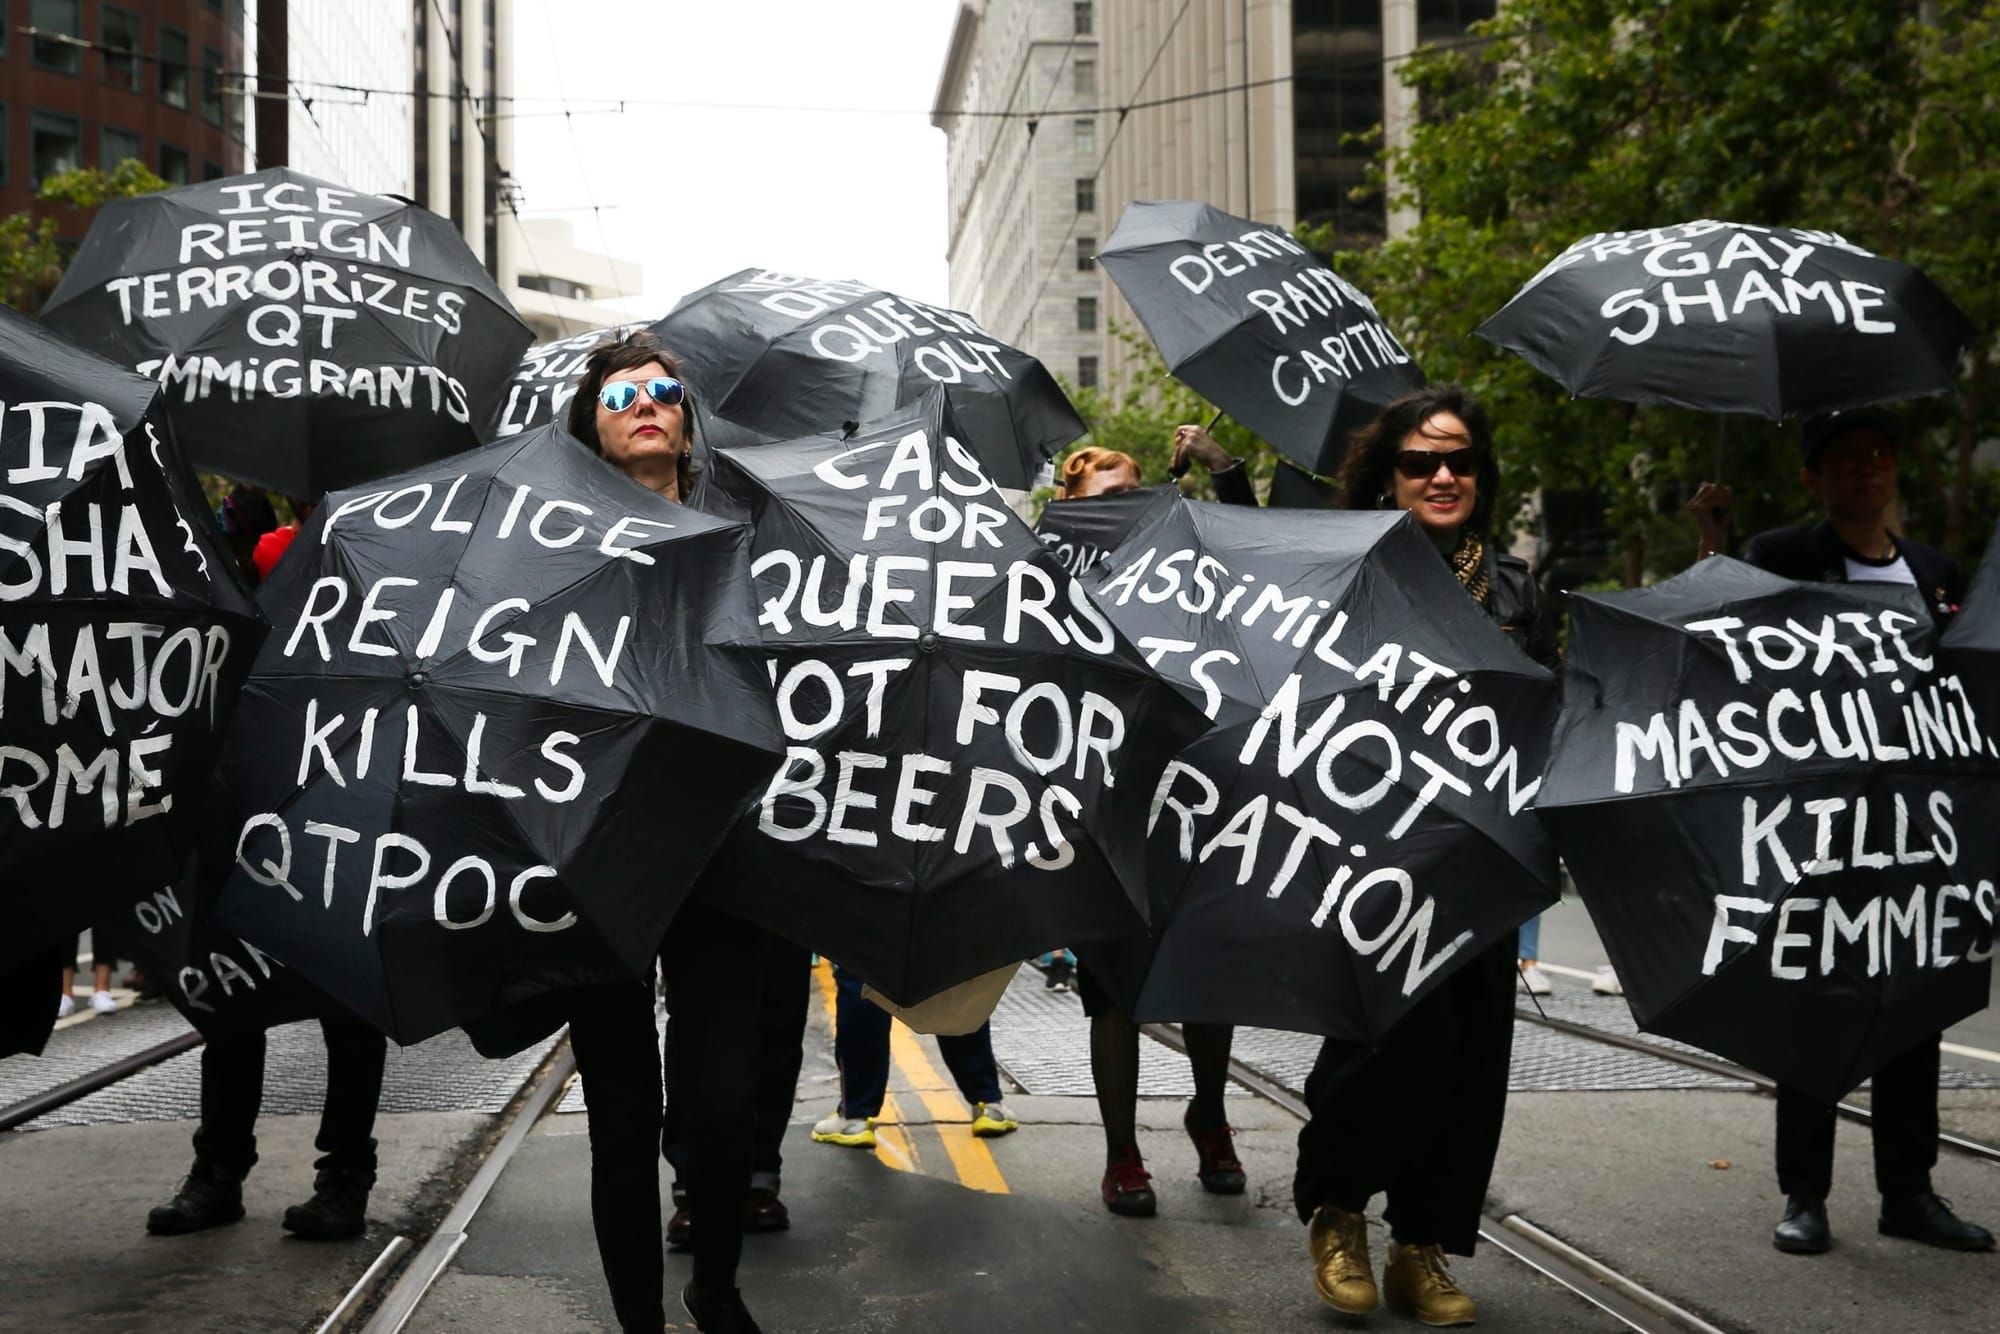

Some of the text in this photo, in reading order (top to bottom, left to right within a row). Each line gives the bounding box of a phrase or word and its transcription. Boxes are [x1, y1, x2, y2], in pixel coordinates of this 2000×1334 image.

[179, 214, 411, 268] REIGN
[218, 182, 363, 218] ICE
[1642, 232, 1815, 277] GAY
[246, 303, 357, 349] QT
[1601, 269, 1896, 345] SHAME
[914, 338, 1013, 384] OUT
[0, 402, 134, 489] IA
[812, 429, 1008, 504] CAS
[321, 473, 676, 565] POLICE
[862, 497, 1008, 549] FOR
[284, 576, 630, 687] REIGN
[750, 549, 1115, 655] QUEERS
[1685, 609, 1933, 684] TOXIC
[0, 623, 230, 731] MAJOR
[766, 657, 1125, 788] OT FOR
[297, 698, 586, 802] KILLS
[1239, 673, 1472, 841] NOT
[1614, 674, 1999, 793] MASCULiNiT
[757, 745, 1083, 870] BEERS
[1741, 790, 1958, 886] KILLS
[135, 885, 183, 934] ON
[236, 812, 578, 937] QTPOC
[1702, 879, 1995, 979] FEMMES
